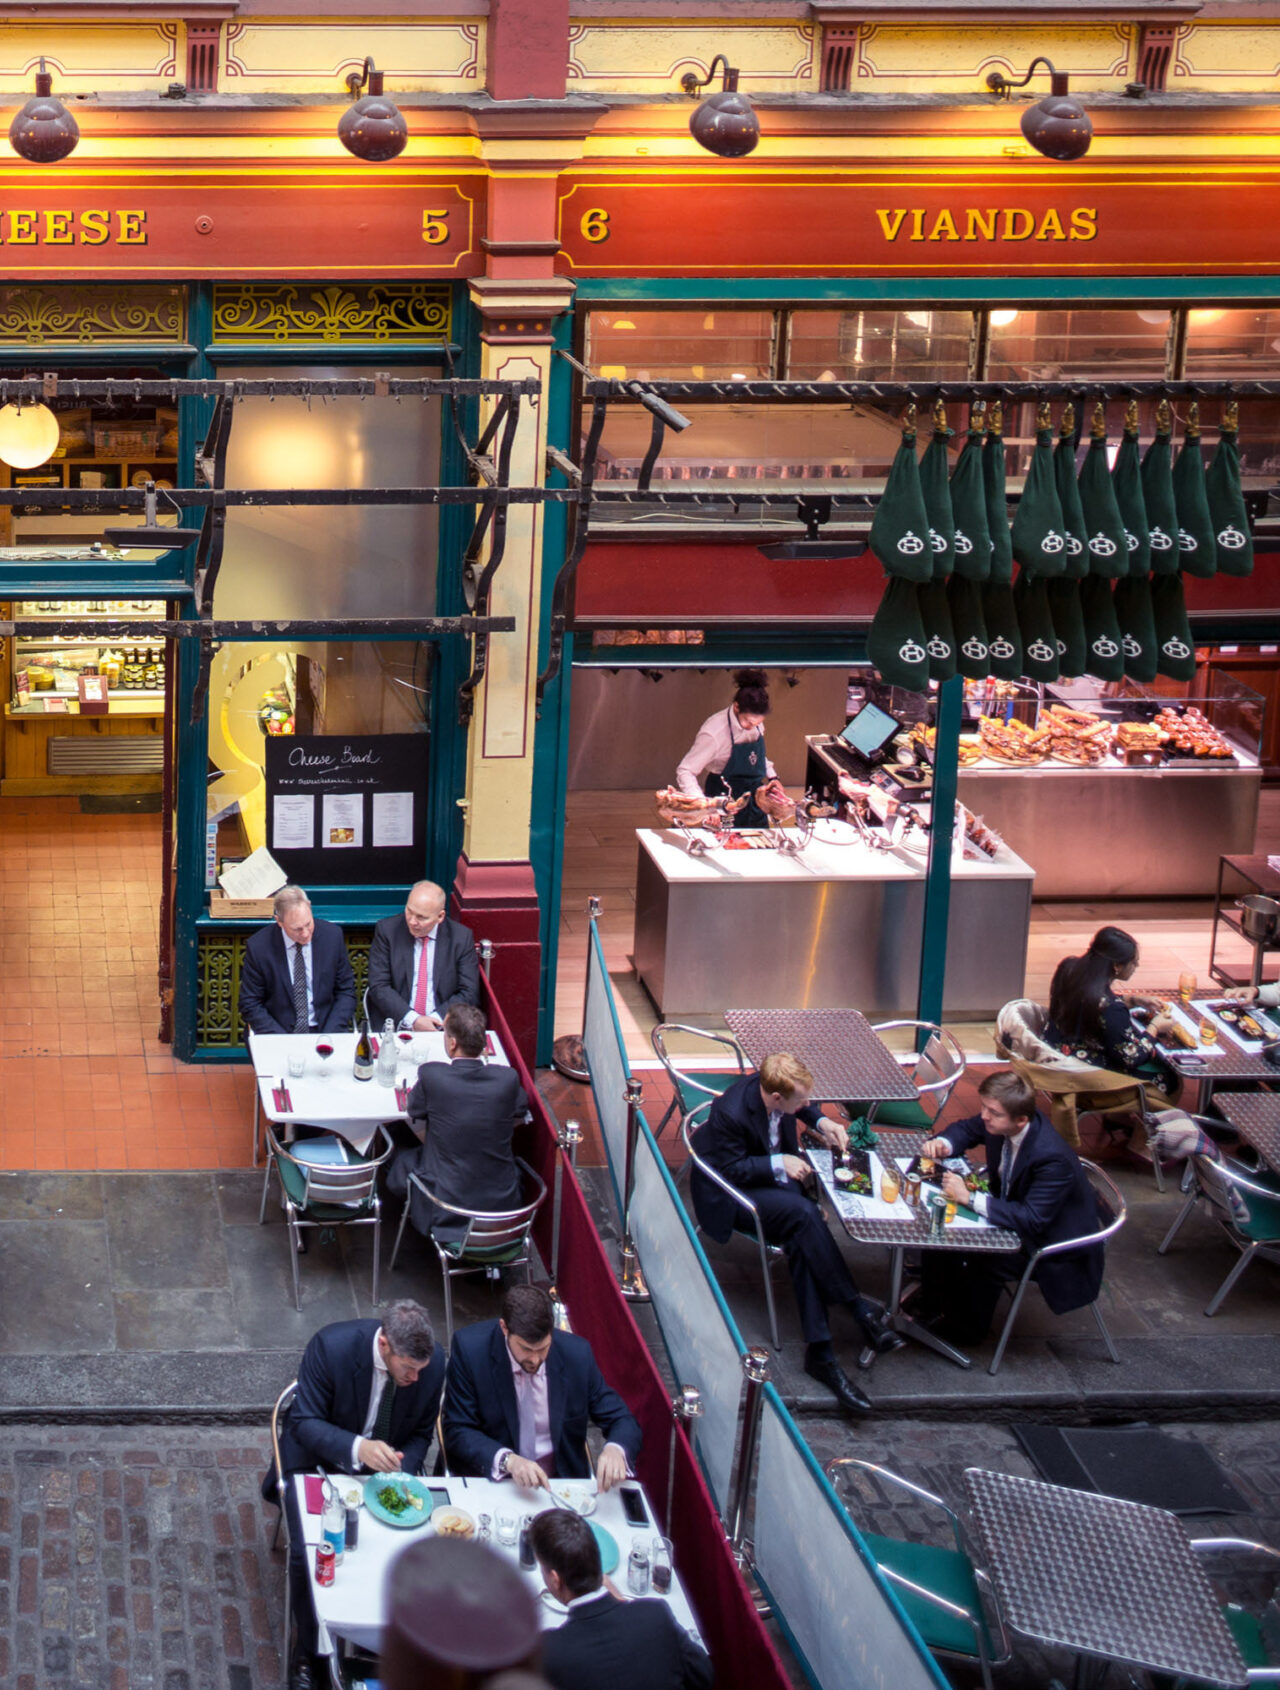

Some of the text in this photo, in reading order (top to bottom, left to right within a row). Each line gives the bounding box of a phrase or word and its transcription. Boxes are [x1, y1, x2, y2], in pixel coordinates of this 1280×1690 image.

[421, 209, 449, 245] 5
[580, 207, 610, 243] 6
[875, 207, 1098, 241] VIANDAS
[288, 746, 336, 767] Cheese
